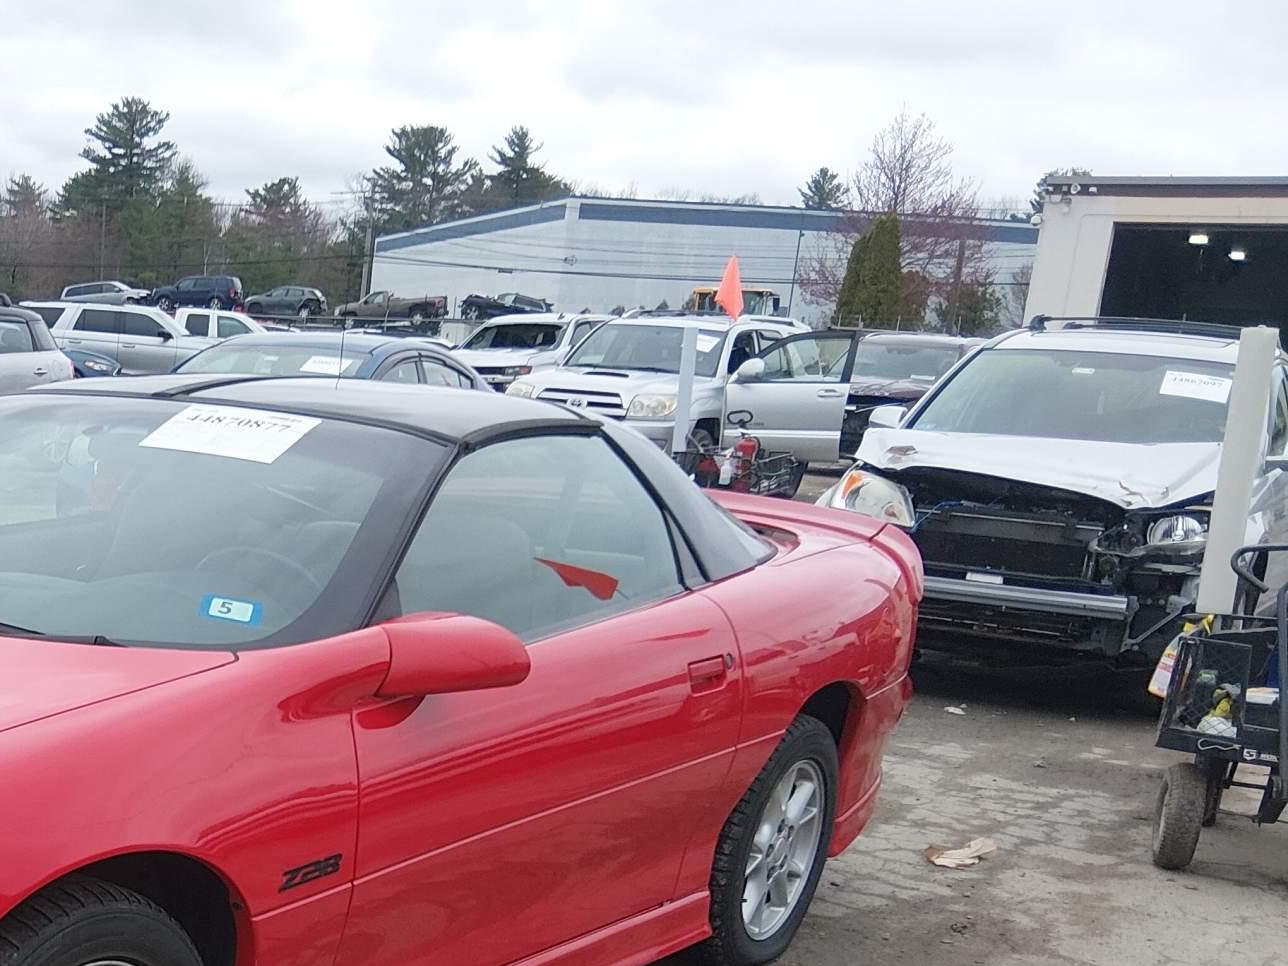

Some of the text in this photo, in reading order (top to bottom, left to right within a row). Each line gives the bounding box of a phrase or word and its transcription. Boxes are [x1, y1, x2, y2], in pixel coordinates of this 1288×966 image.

[185, 413, 292, 433] 44870877
[217, 601, 233, 615] 5
[278, 853, 344, 894] Z28
